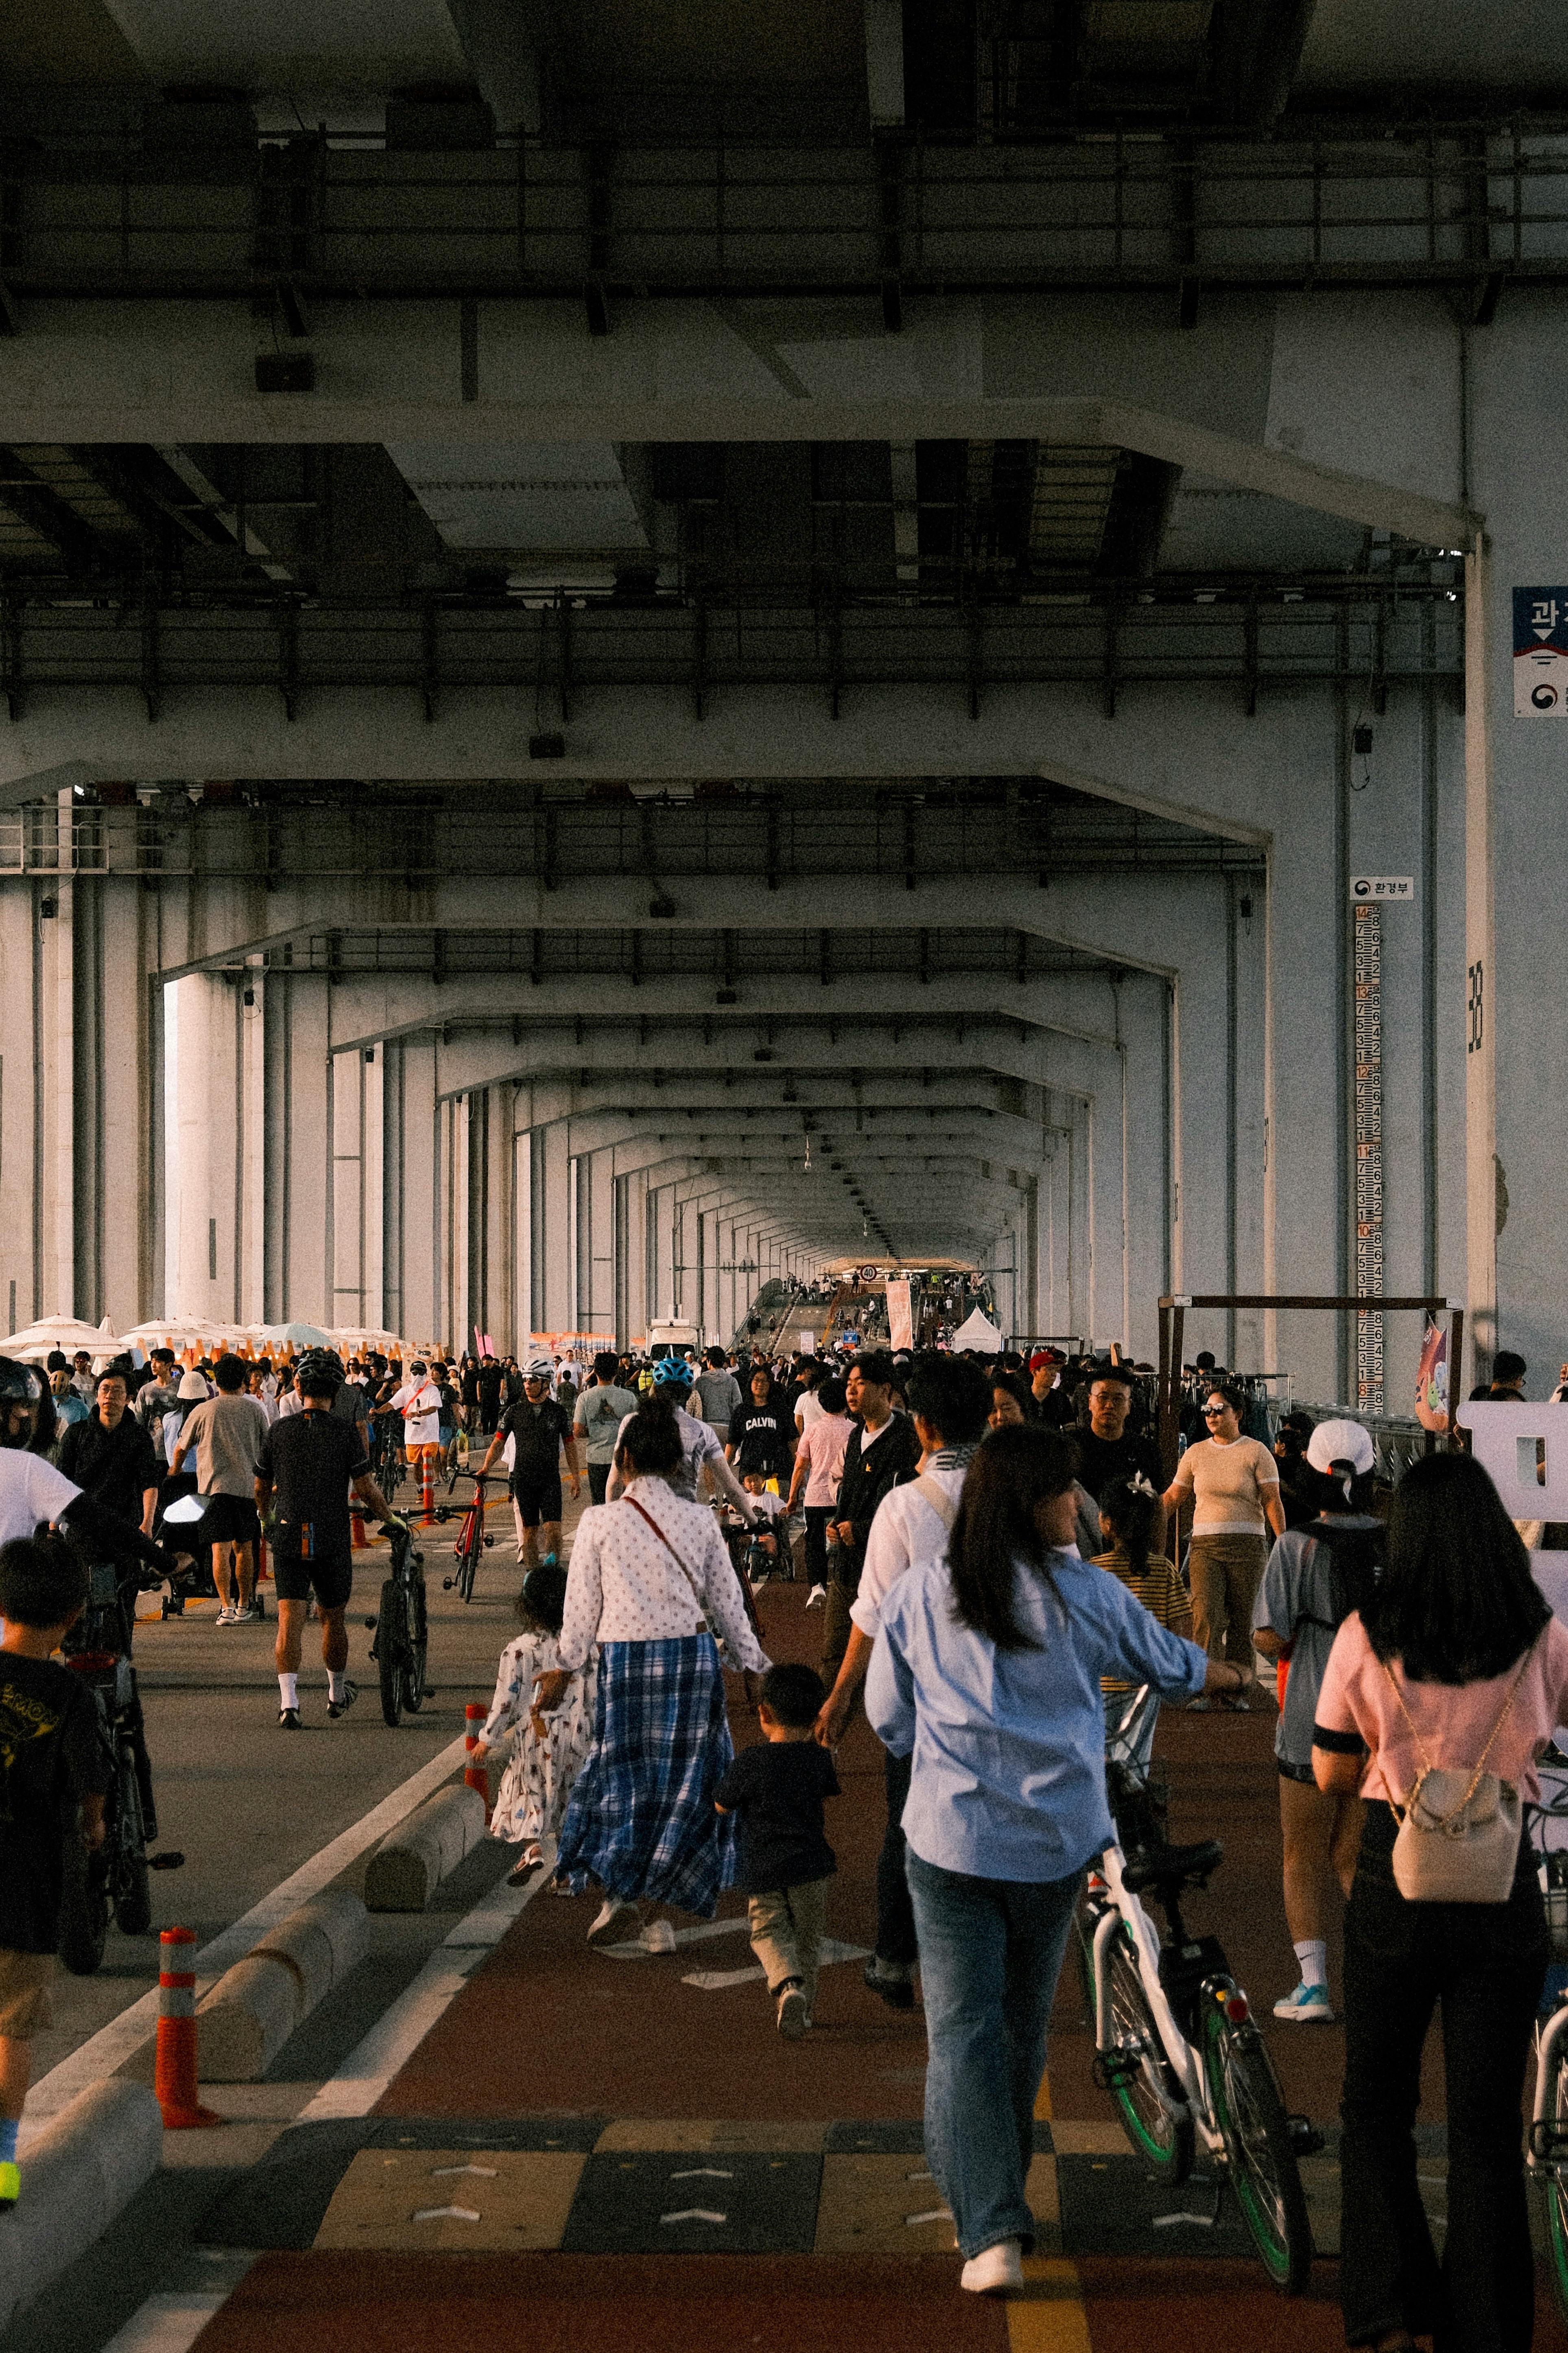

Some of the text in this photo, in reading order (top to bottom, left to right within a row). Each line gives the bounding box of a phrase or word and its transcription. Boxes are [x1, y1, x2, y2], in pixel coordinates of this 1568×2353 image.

[1531, 599, 1568, 627] 과
[1375, 882, 1408, 894] 환경부
[1356, 908, 1367, 918] 14
[1372, 916, 1379, 926] 8
[1357, 925, 1363, 934] 7
[1372, 932, 1379, 942] 6
[1357, 940, 1363, 950] 5
[1373, 948, 1379, 957] 4
[1357, 956, 1363, 965] 3
[1373, 964, 1379, 973] 2
[1358, 972, 1361, 982] 1
[1357, 987, 1367, 998] 13
[1373, 996, 1380, 1005] 8
[1357, 1004, 1364, 1013] 7
[1373, 1012, 1380, 1021] 6
[1357, 1020, 1364, 1029] 5
[1373, 1028, 1380, 1037] 4
[1358, 1036, 1364, 1045] 3
[1374, 1043, 1380, 1053] 2
[1358, 1052, 1362, 1061] 1
[1357, 1067, 1368, 1078] 12
[1374, 1075, 1380, 1085] 8
[1358, 1084, 1364, 1093] 7
[1374, 1091, 1380, 1101] 6
[1358, 1100, 1364, 1109] 5
[1374, 1107, 1380, 1116] 4
[1358, 1115, 1364, 1124] 3
[1374, 1123, 1380, 1132] 2
[1358, 1131, 1362, 1141] 1
[1358, 1146, 1369, 1157] 11
[1374, 1155, 1380, 1164] 8
[1358, 1163, 1365, 1172] 7
[1374, 1170, 1381, 1180] 6
[1358, 1179, 1365, 1188] 5
[1374, 1186, 1381, 1196] 4
[1358, 1194, 1365, 1204] 3
[1374, 1202, 1381, 1212] 2
[1359, 1211, 1363, 1220] 1
[1358, 1226, 1369, 1236] 10
[1374, 1234, 1381, 1244] 8
[1359, 1242, 1365, 1252] 7
[1374, 1250, 1381, 1260] 6
[1359, 1259, 1365, 1268] 5
[864, 1268, 873, 1277] 40
[1375, 1266, 1382, 1275] 4
[1359, 1274, 1365, 1284] 3
[1375, 1282, 1382, 1291] 2
[1375, 1314, 1382, 1323] 8
[1359, 1322, 1366, 1332] 7
[1375, 1330, 1382, 1339] 6
[1359, 1338, 1366, 1347] 5
[1375, 1345, 1382, 1355] 4
[1360, 1354, 1366, 1363] 3
[1376, 1361, 1382, 1371] 2
[1360, 1370, 1364, 1379] 1
[1359, 1385, 1366, 1396] 8
[1376, 1393, 1382, 1403] 8
[1360, 1402, 1367, 1410] 7
[746, 1417, 776, 1431] CALVIN
